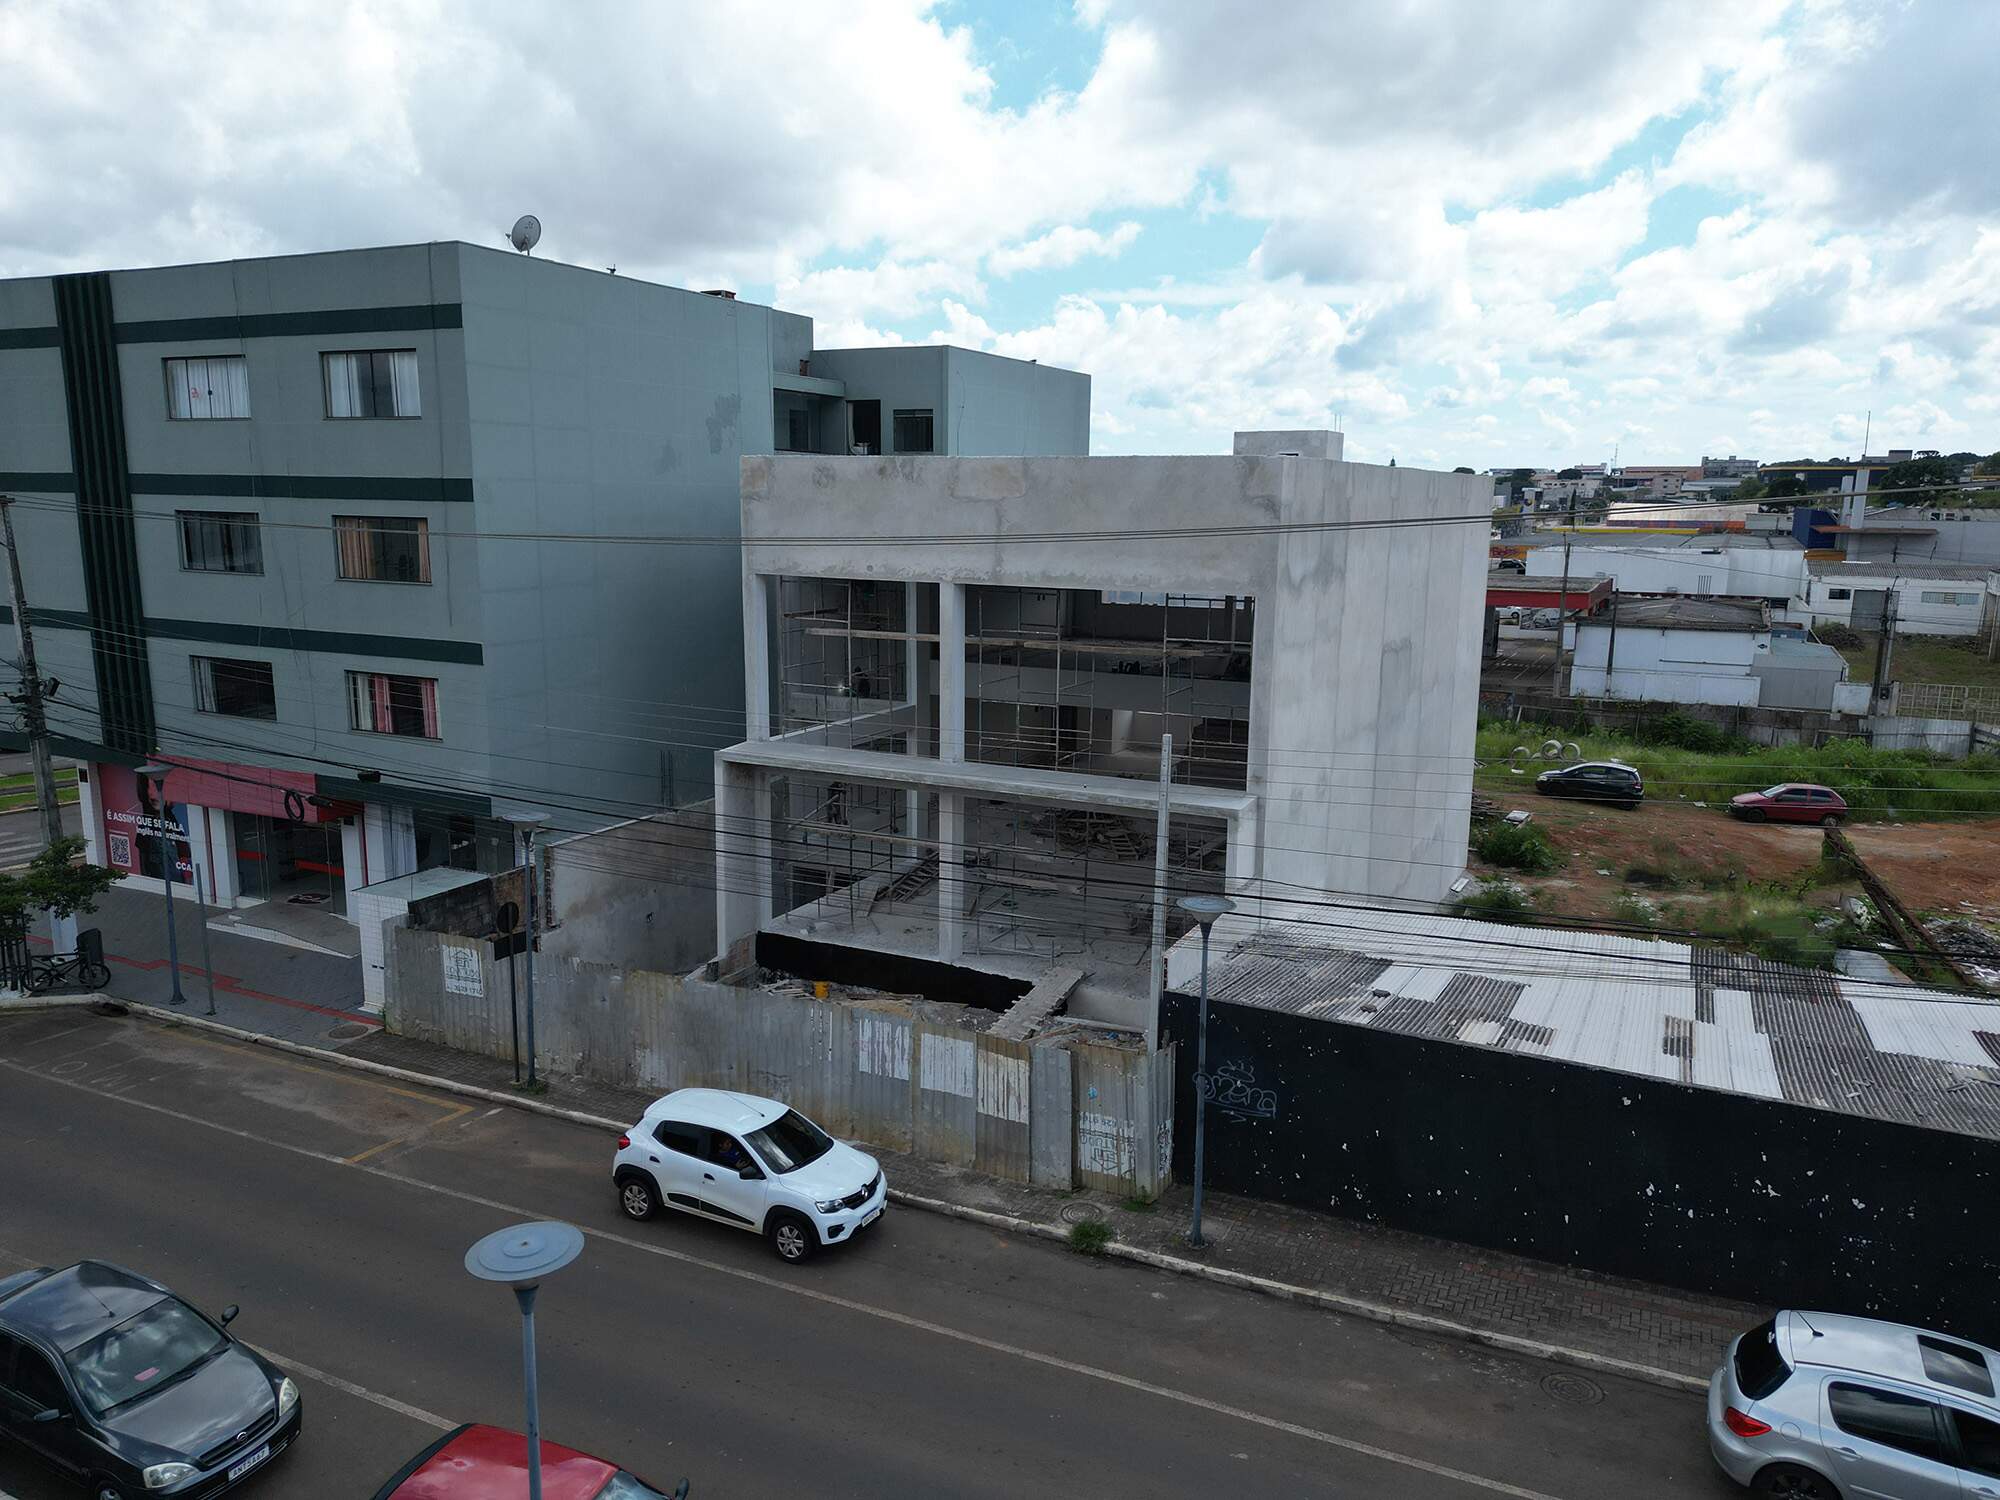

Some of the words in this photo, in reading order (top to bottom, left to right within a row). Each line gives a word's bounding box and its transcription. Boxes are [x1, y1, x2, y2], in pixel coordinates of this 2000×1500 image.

[107, 809, 112, 820] É
[113, 812, 135, 823] ASSIM
[136, 816, 152, 827] QUE
[165, 820, 184, 832] FALA
